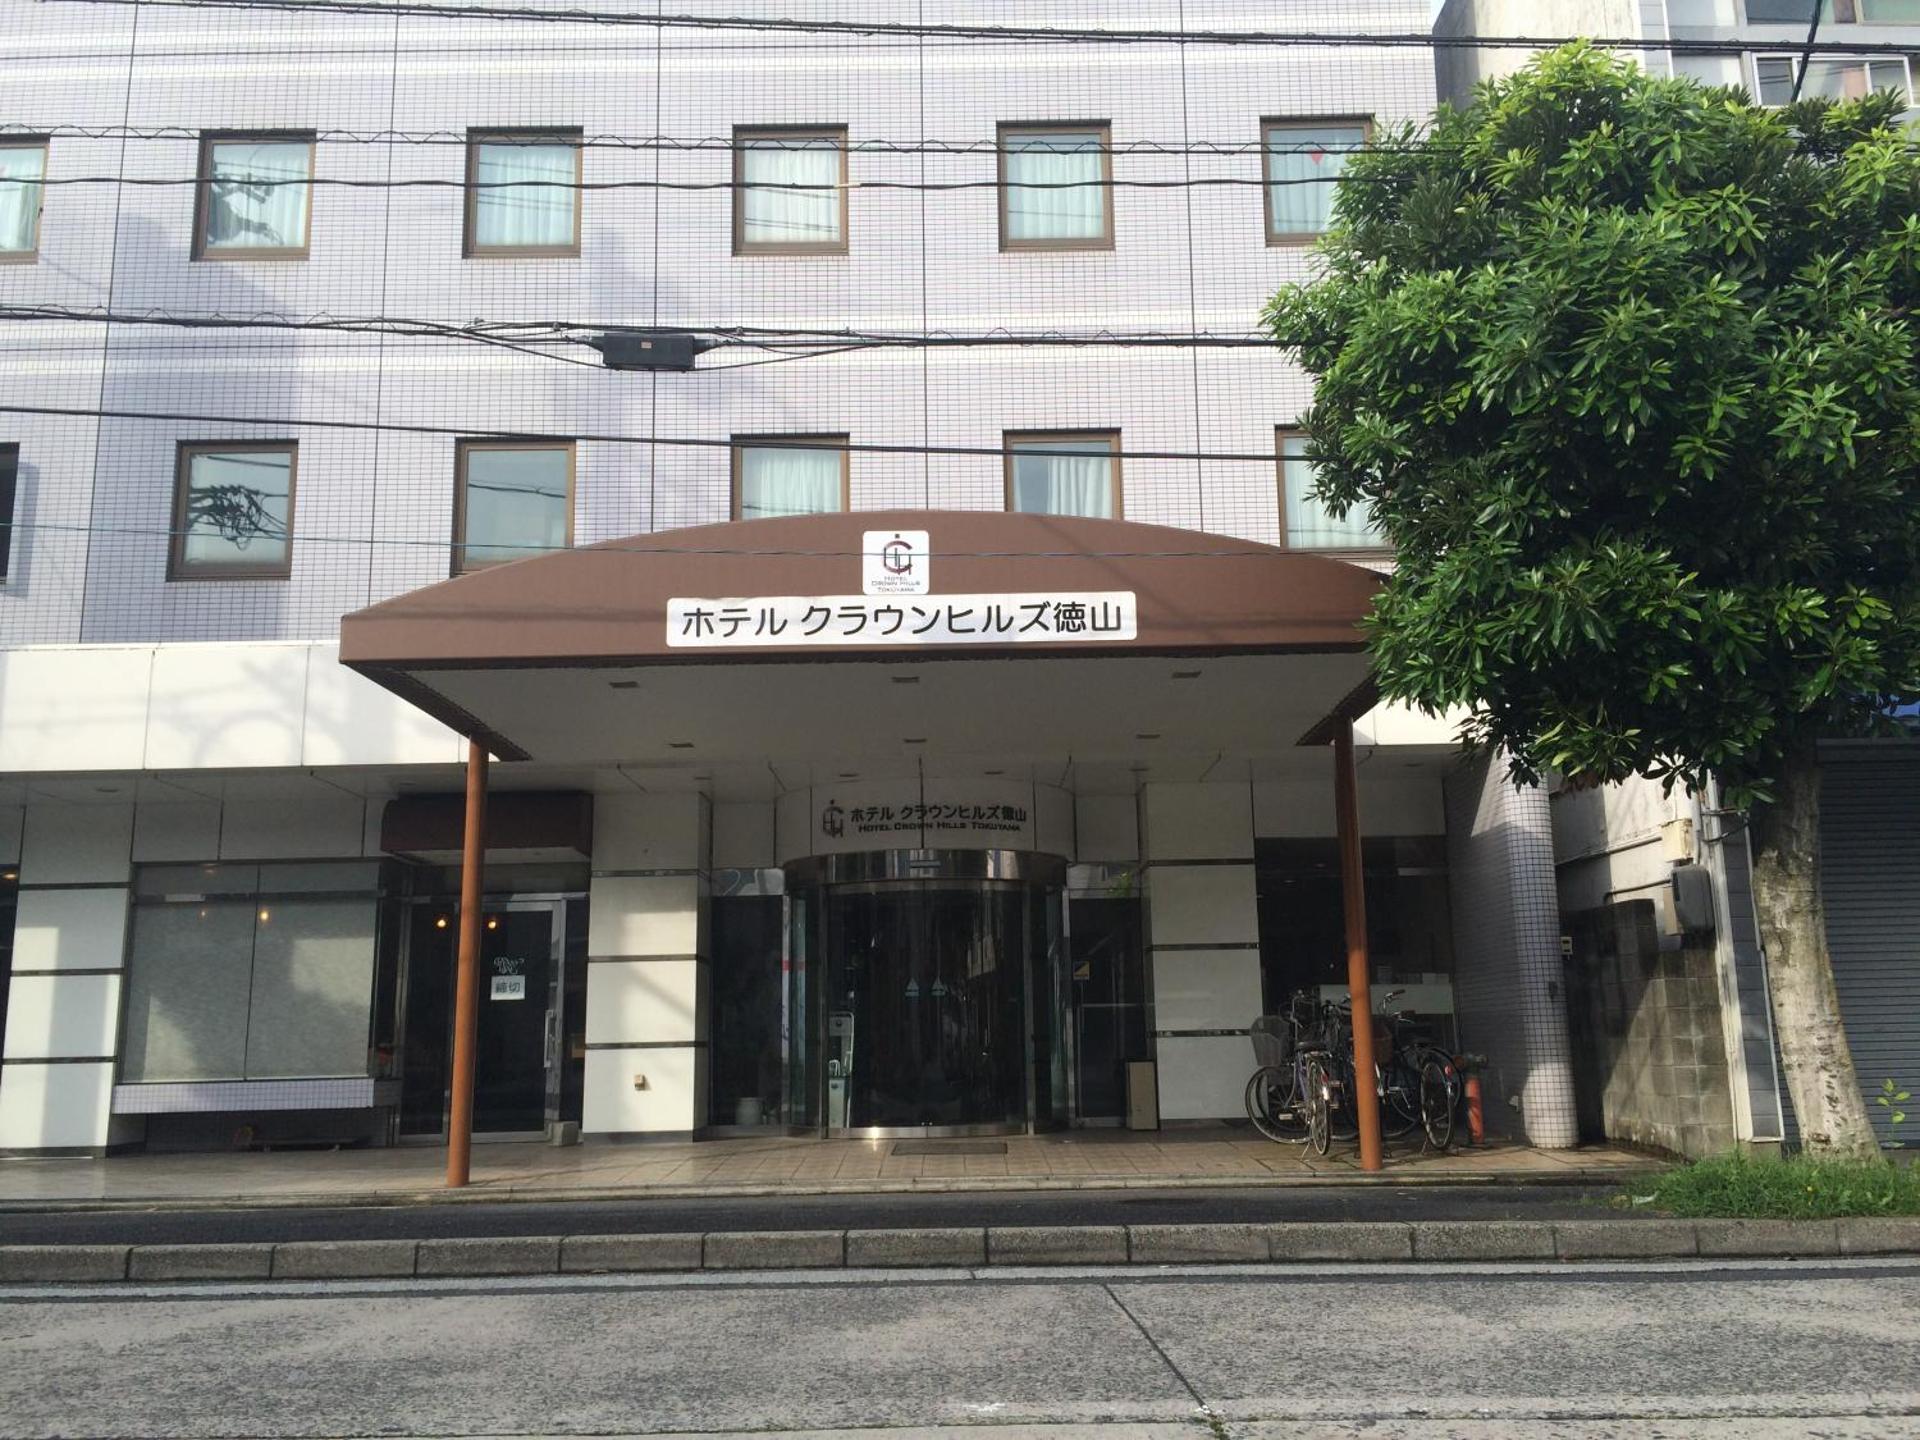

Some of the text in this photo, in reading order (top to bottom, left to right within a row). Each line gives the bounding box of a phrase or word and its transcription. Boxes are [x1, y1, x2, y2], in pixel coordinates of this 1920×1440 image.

[682, 601, 1122, 638] ホテル クラウンヒルズ徳山
[850, 807, 895, 822] ホテル
[858, 821, 1021, 833] HOTEL CROWN HILLS TOKUYAMA
